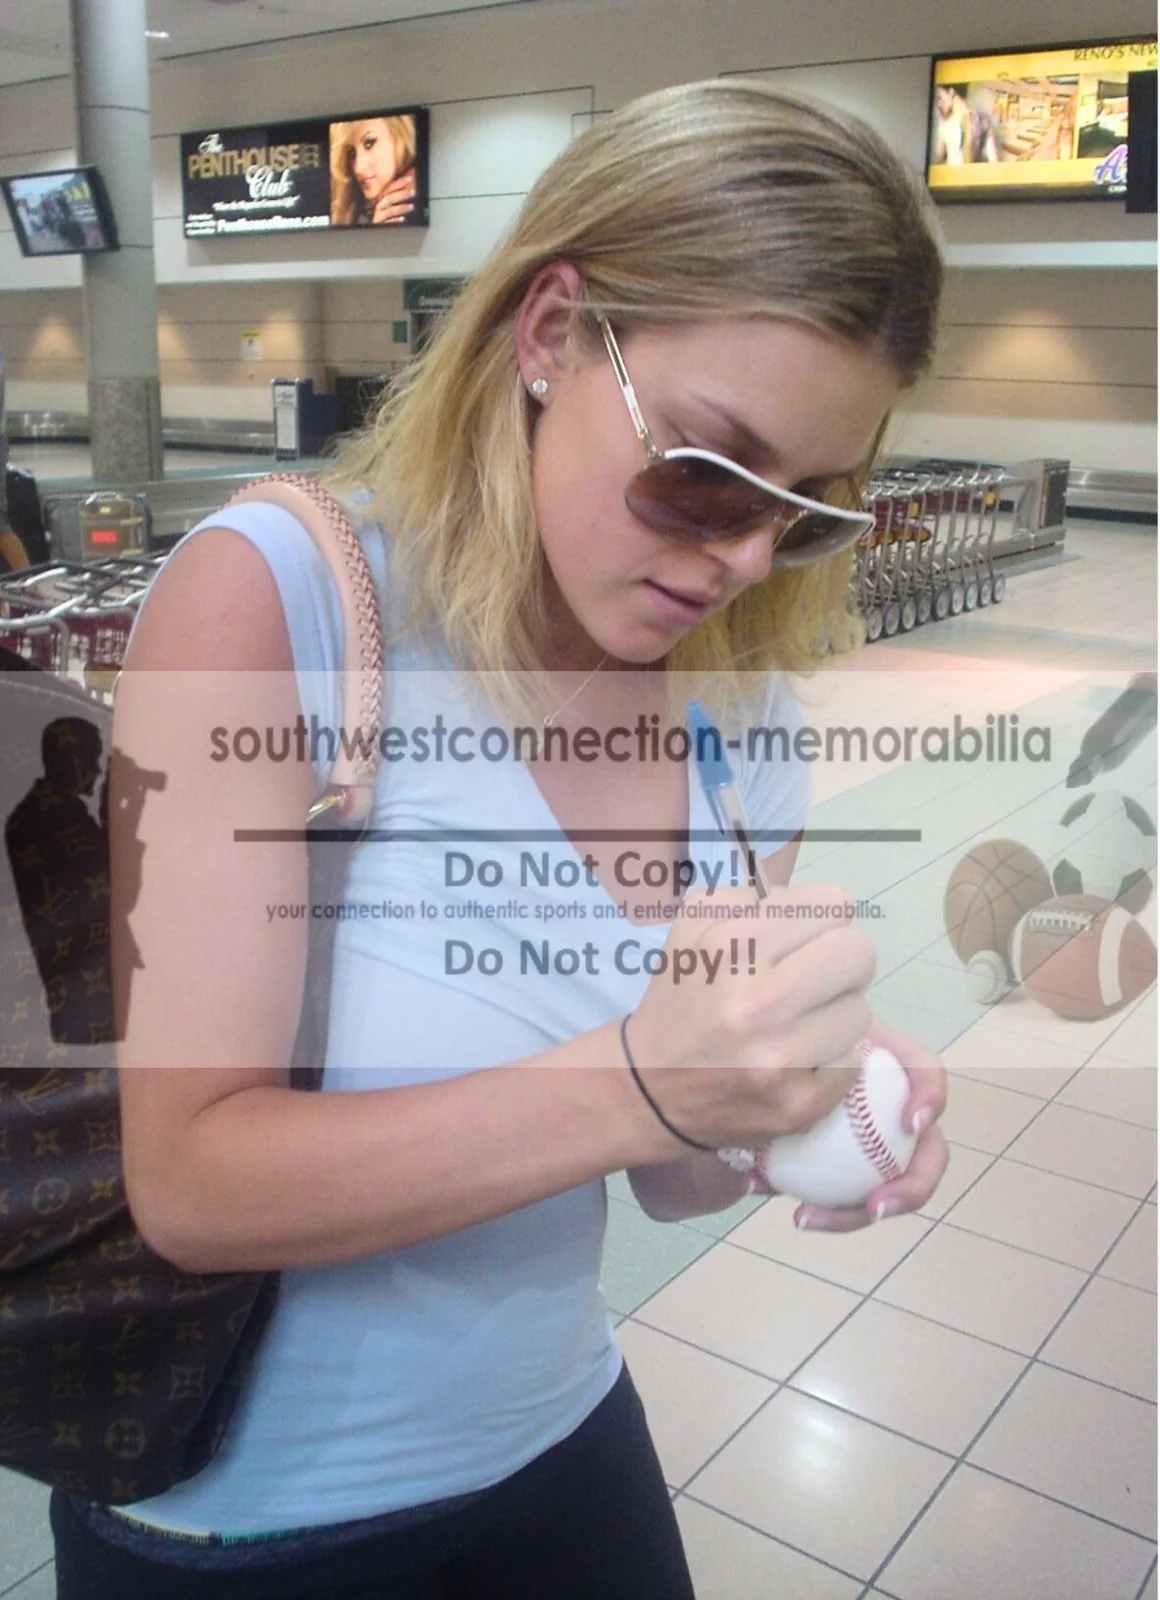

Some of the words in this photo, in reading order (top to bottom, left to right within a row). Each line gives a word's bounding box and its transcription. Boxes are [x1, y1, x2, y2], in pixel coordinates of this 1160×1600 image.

[187, 144, 301, 179] PENTHOUSE
[198, 133, 224, 155] The
[245, 164, 293, 199] Club
